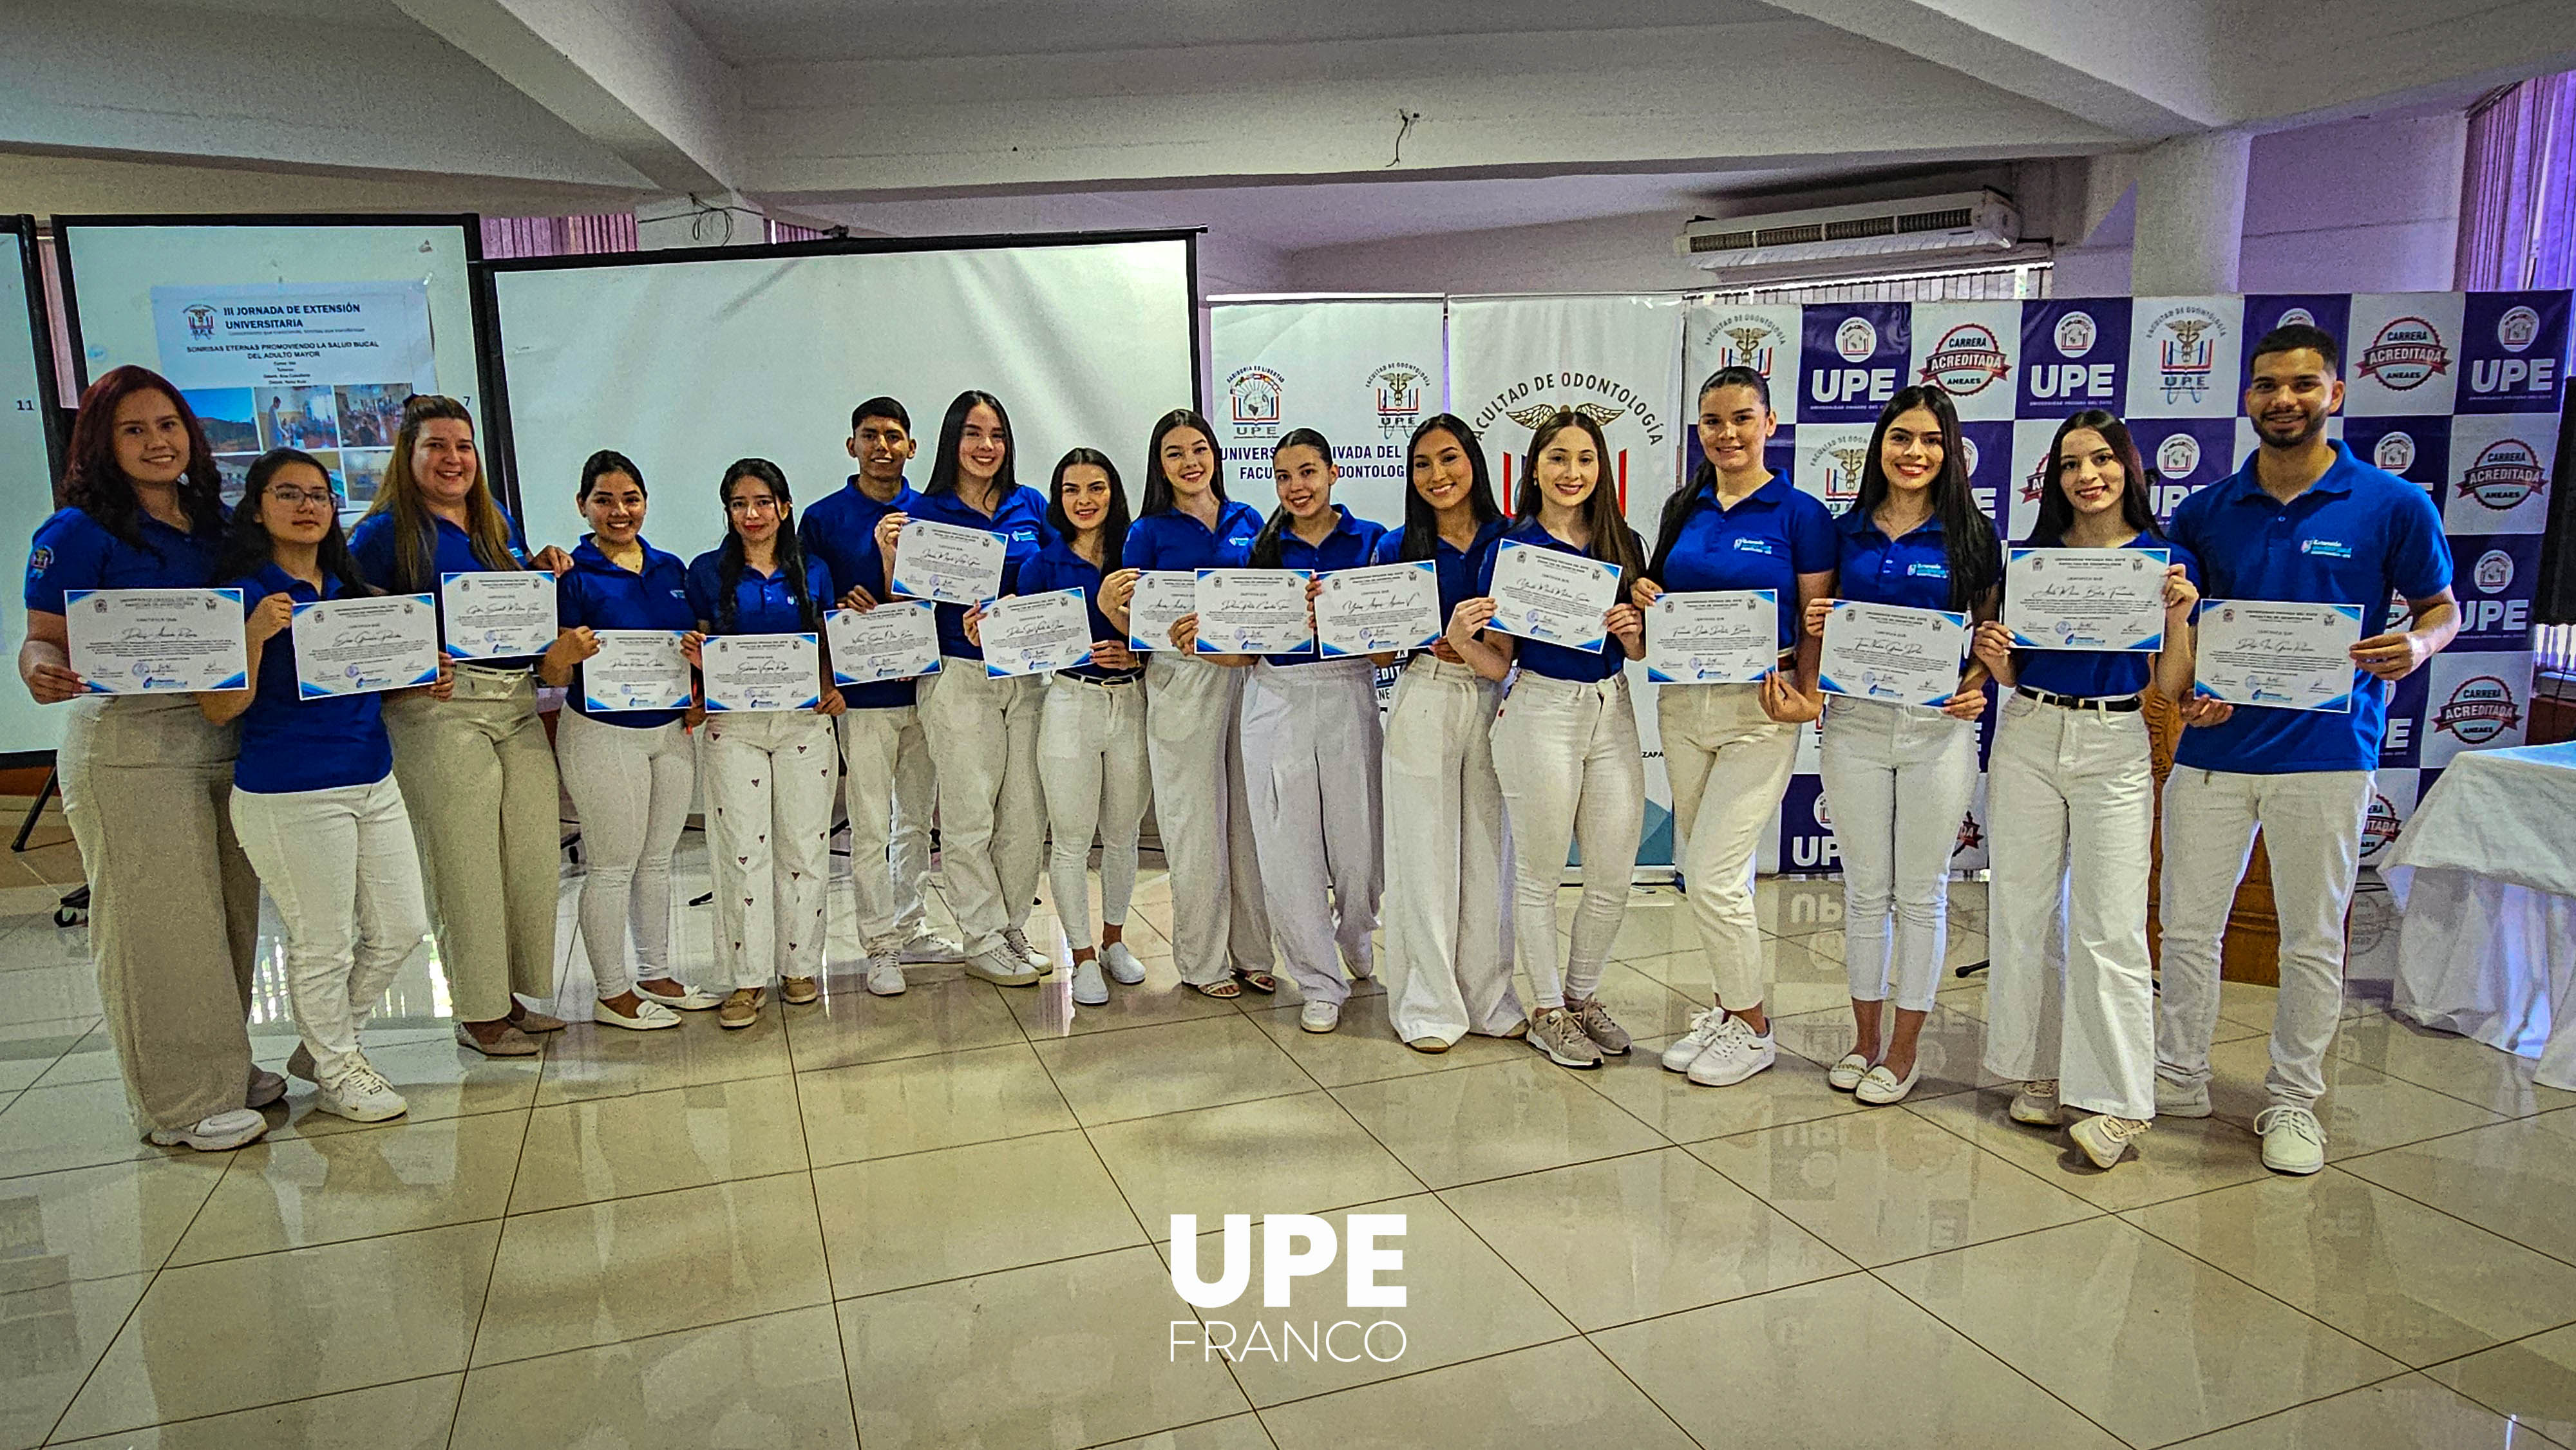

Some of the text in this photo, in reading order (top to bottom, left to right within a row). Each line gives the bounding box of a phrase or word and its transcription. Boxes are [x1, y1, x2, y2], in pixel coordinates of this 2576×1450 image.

[223, 307, 234, 315] III
[237, 306, 284, 315] JORNADA
[287, 305, 301, 314] DE
[303, 301, 360, 314] EXTENSIÓN
[225, 319, 303, 329] UNIVERSITARIA
[1949, 337, 1987, 348] CARRERA
[2387, 331, 2427, 341] CARRERA
[1931, 354, 2001, 371] ACREDITADA
[2369, 348, 2442, 364] ACREDITADA
[2031, 364, 2115, 398] UPE
[2165, 377, 2205, 386] UPE
[2472, 358, 2555, 393] UPE
[1812, 369, 1896, 402] UPE
[16, 399, 35, 411] 11
[463, 396, 470, 406] 7
[1473, 372, 1663, 446] ACULTAD DE ODONTOLOGÍA
[1221, 446, 1401, 460] UNIVERS IVADA DEL
[2487, 452, 2526, 462] CARRERA
[1240, 465, 1405, 479] FACU DONTOLOG
[2470, 469, 2540, 484] ACREDITADA
[2457, 599, 2530, 632] UPE
[2463, 689, 2501, 699] CARRERA
[2445, 705, 2512, 720] ACREDITADA
[1792, 836, 1842, 866] UP
